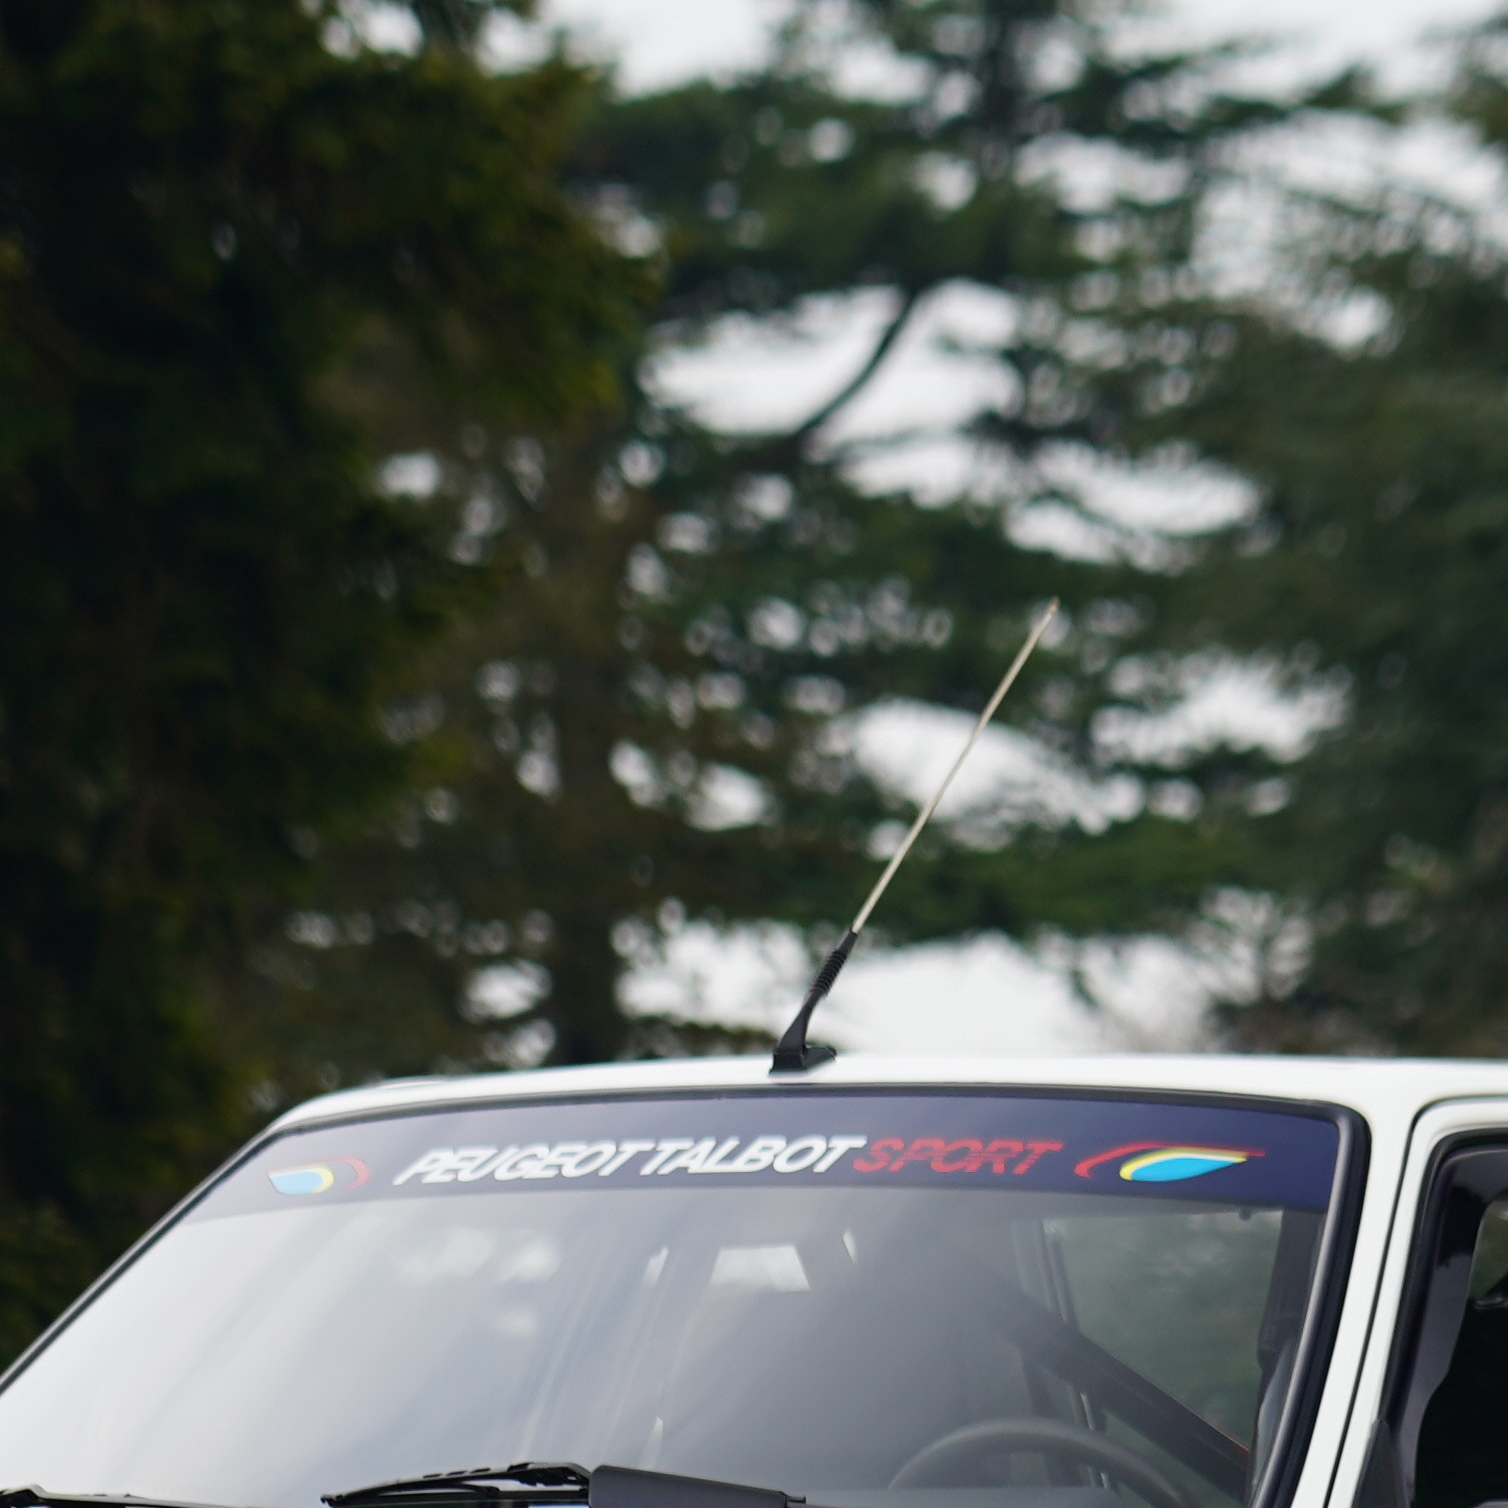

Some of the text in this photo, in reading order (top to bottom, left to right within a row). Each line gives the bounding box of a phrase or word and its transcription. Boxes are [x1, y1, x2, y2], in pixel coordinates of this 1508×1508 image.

[392, 1134, 1065, 1186] PEUGEOT TALBOT SPORT
